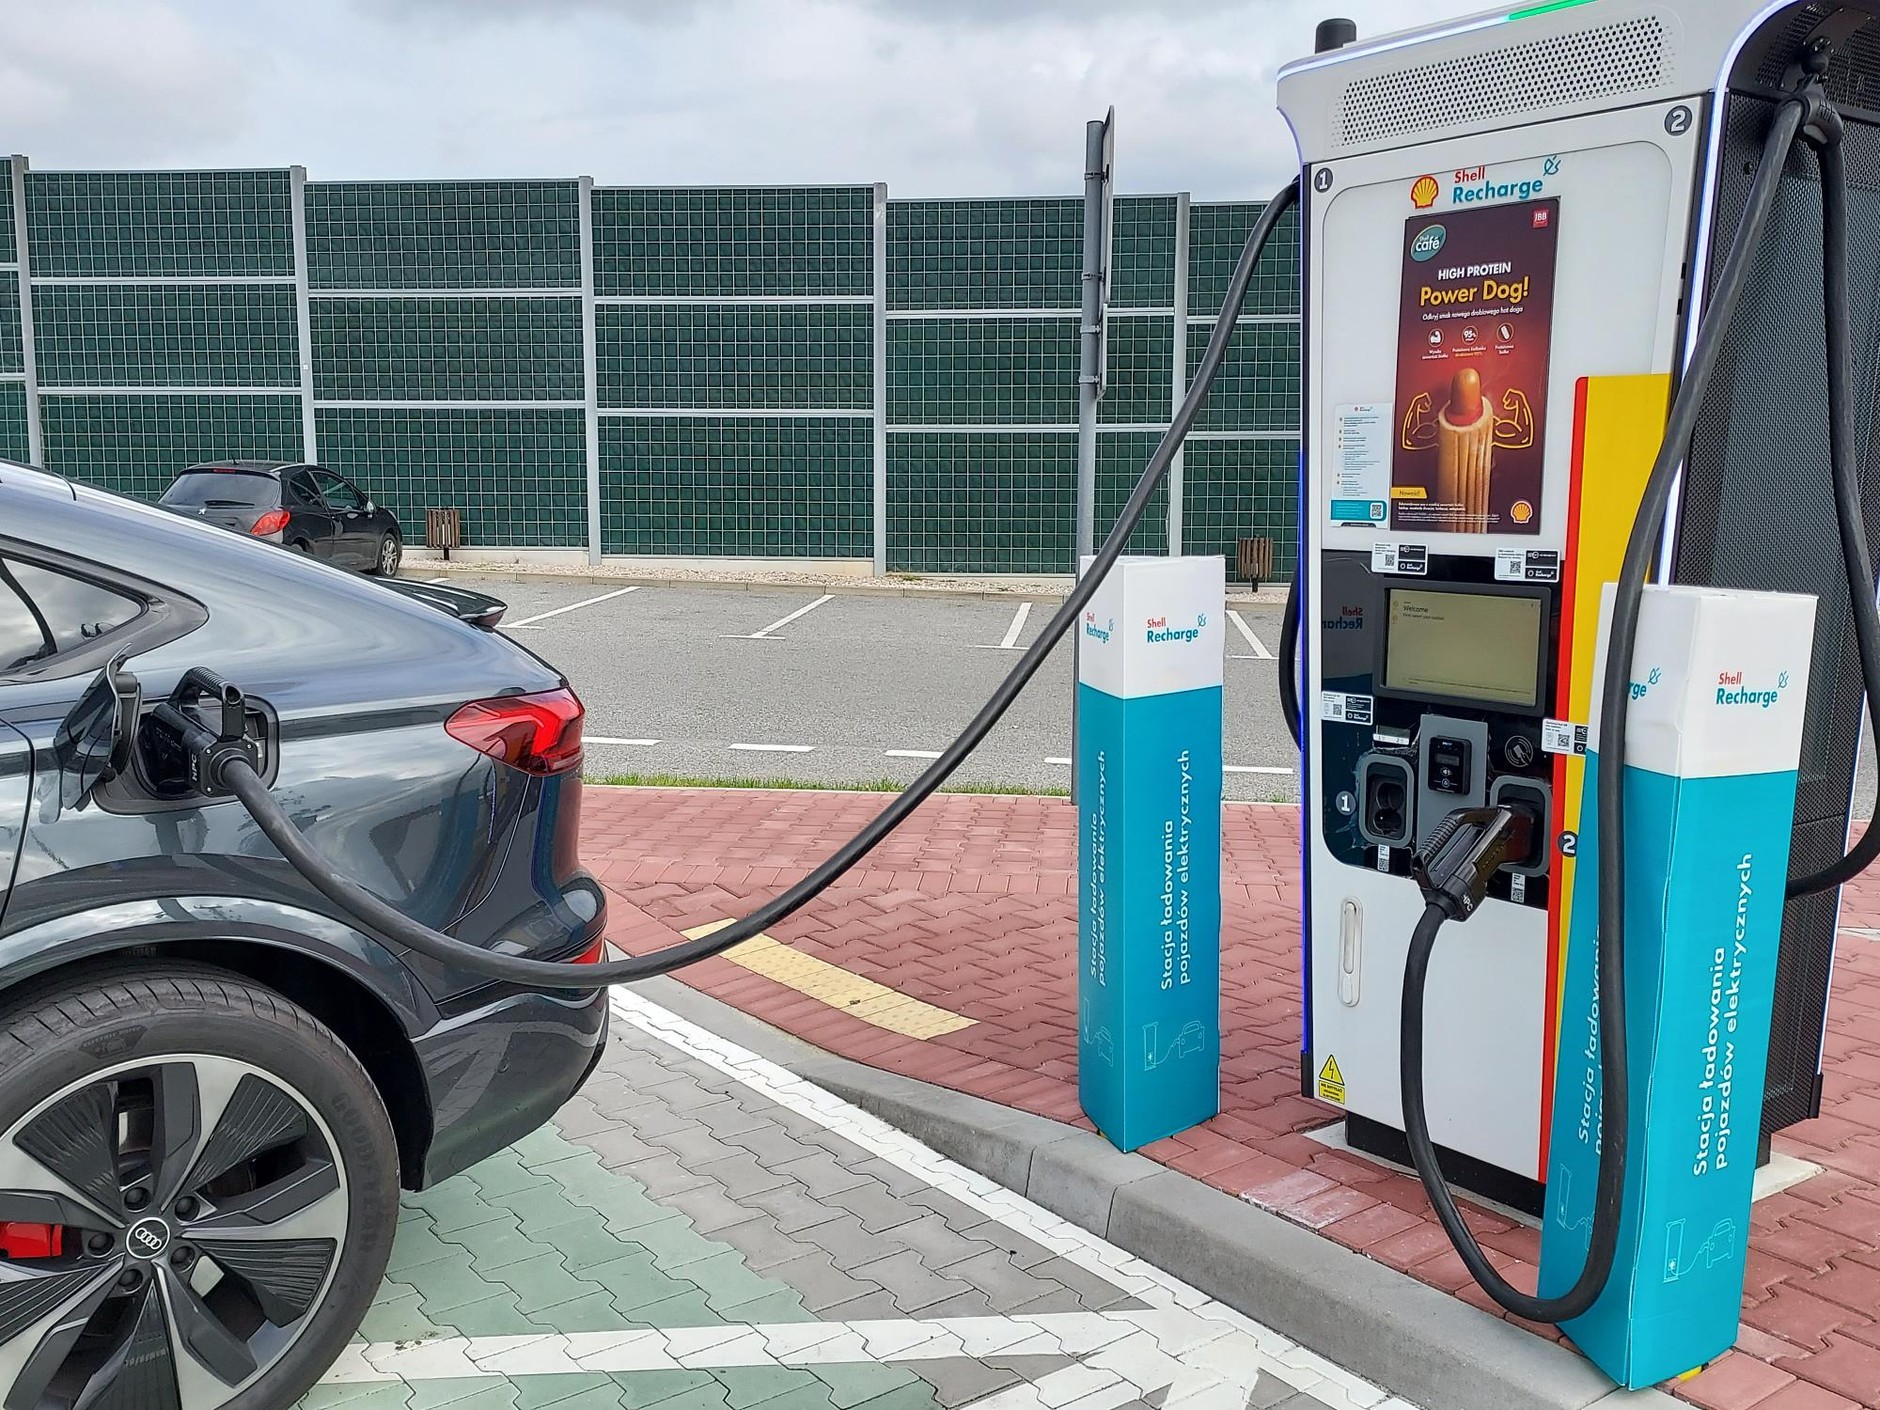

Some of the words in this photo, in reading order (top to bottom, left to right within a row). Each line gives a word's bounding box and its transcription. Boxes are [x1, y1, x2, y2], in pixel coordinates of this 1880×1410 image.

[1671, 110, 1686, 132] 2
[1319, 171, 1328, 190] 1
[1454, 166, 1485, 184] Shell
[1452, 180, 1543, 204] Recharge
[1415, 236, 1440, 252] café
[1438, 266, 1465, 280] HIGH
[1467, 261, 1512, 277] PROTEIN
[1420, 286, 1478, 306] Power
[1483, 276, 1529, 304] Dog!
[1402, 604, 1429, 613] Welcome
[1086, 622, 1109, 644] Recharge
[1146, 628, 1199, 643] Recharge
[1147, 617, 1167, 629] Shell
[1718, 672, 1743, 685] Shell
[1716, 686, 1778, 708] Recharge
[1097, 750, 1107, 883] elektrycznych
[1176, 749, 1193, 883] elektrycznych
[1341, 794, 1351, 812] 1
[1562, 834, 1576, 854] 2
[1090, 813, 1098, 915] ładowania
[1160, 820, 1173, 926] ładowania
[1090, 919, 1099, 978] Stacja
[1097, 888, 1107, 987] pojazdów
[1176, 889, 1191, 985] pojazdów
[1723, 853, 1753, 1033] elektrycznych
[1160, 930, 1176, 990] Stacja
[1699, 947, 1725, 1090] ładowania
[1578, 1067, 1596, 1144] Stacja
[1715, 1042, 1735, 1170] pojazdów
[1693, 1095, 1715, 1177] Stacja
